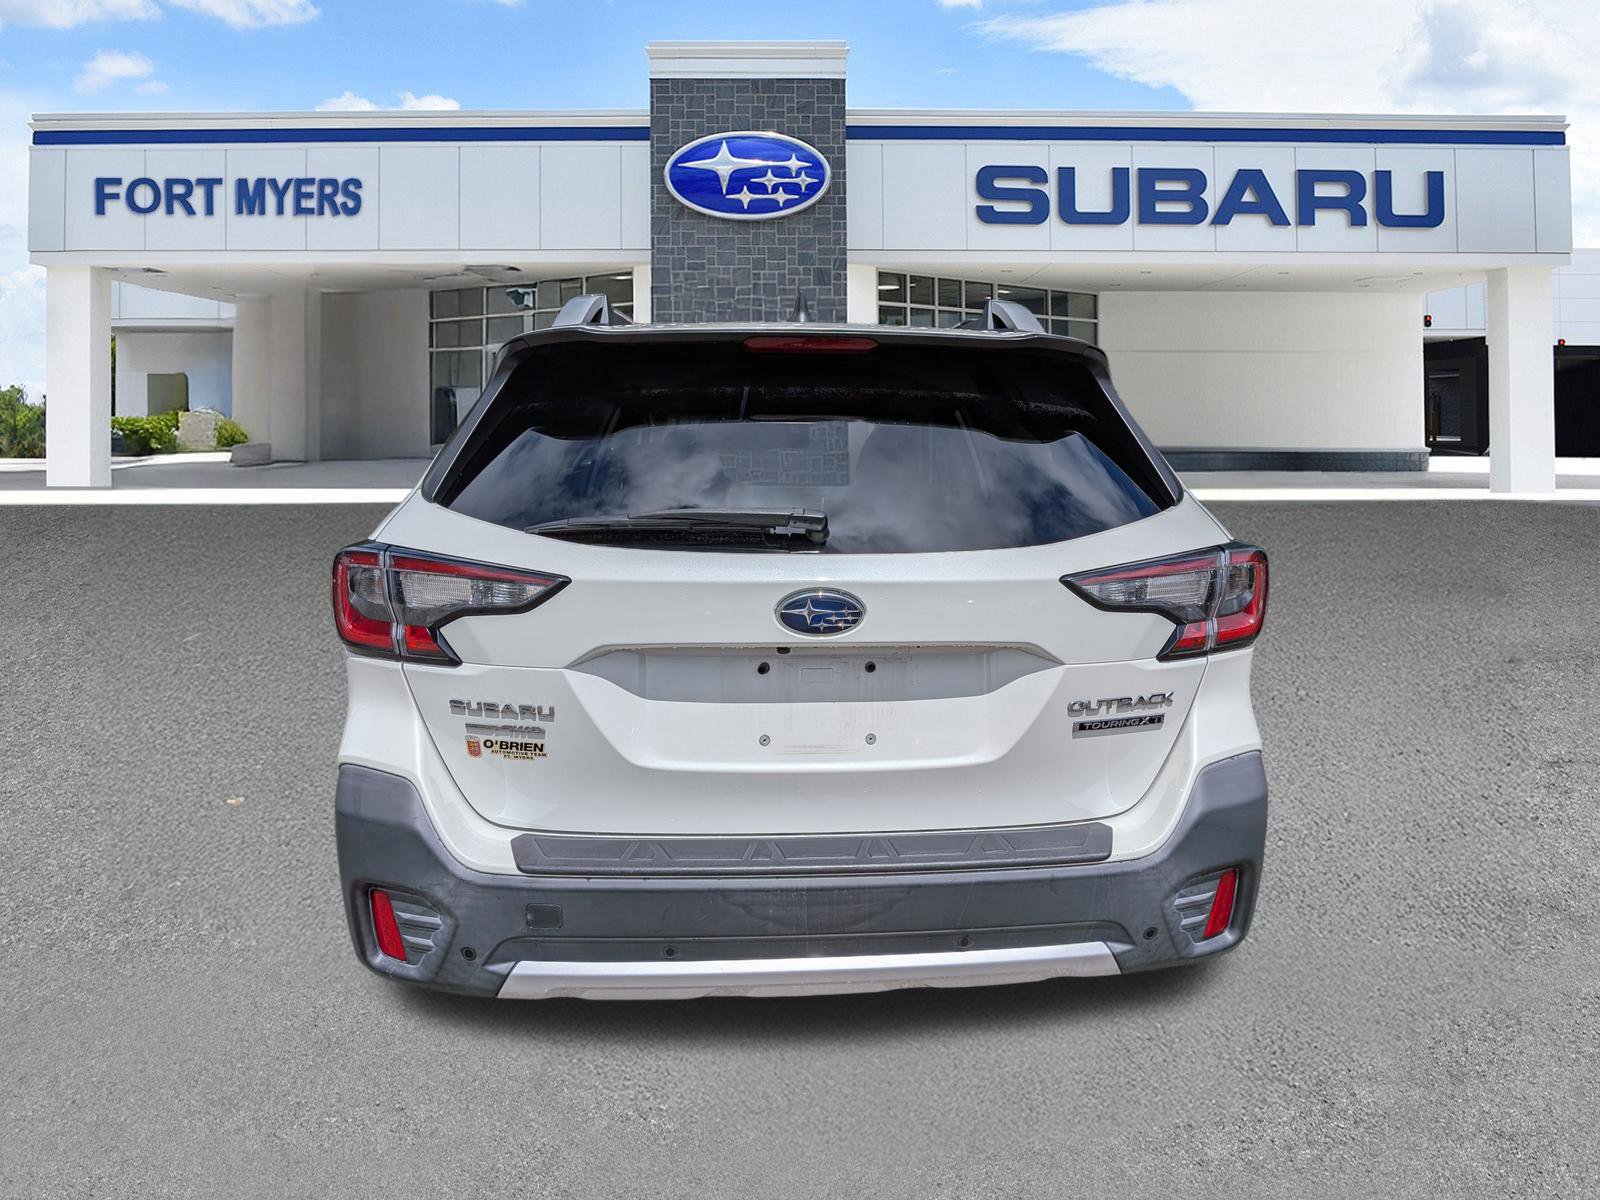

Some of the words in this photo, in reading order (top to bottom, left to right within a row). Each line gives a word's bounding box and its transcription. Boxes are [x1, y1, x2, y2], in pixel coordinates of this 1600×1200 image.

[94, 177, 222, 216] FORT
[235, 177, 363, 217] MYERS
[975, 164, 1446, 229] SUBARU
[449, 699, 555, 722] SUBARU
[1067, 691, 1175, 717] OUTBACK
[483, 739, 545, 753] O'BRIEN
